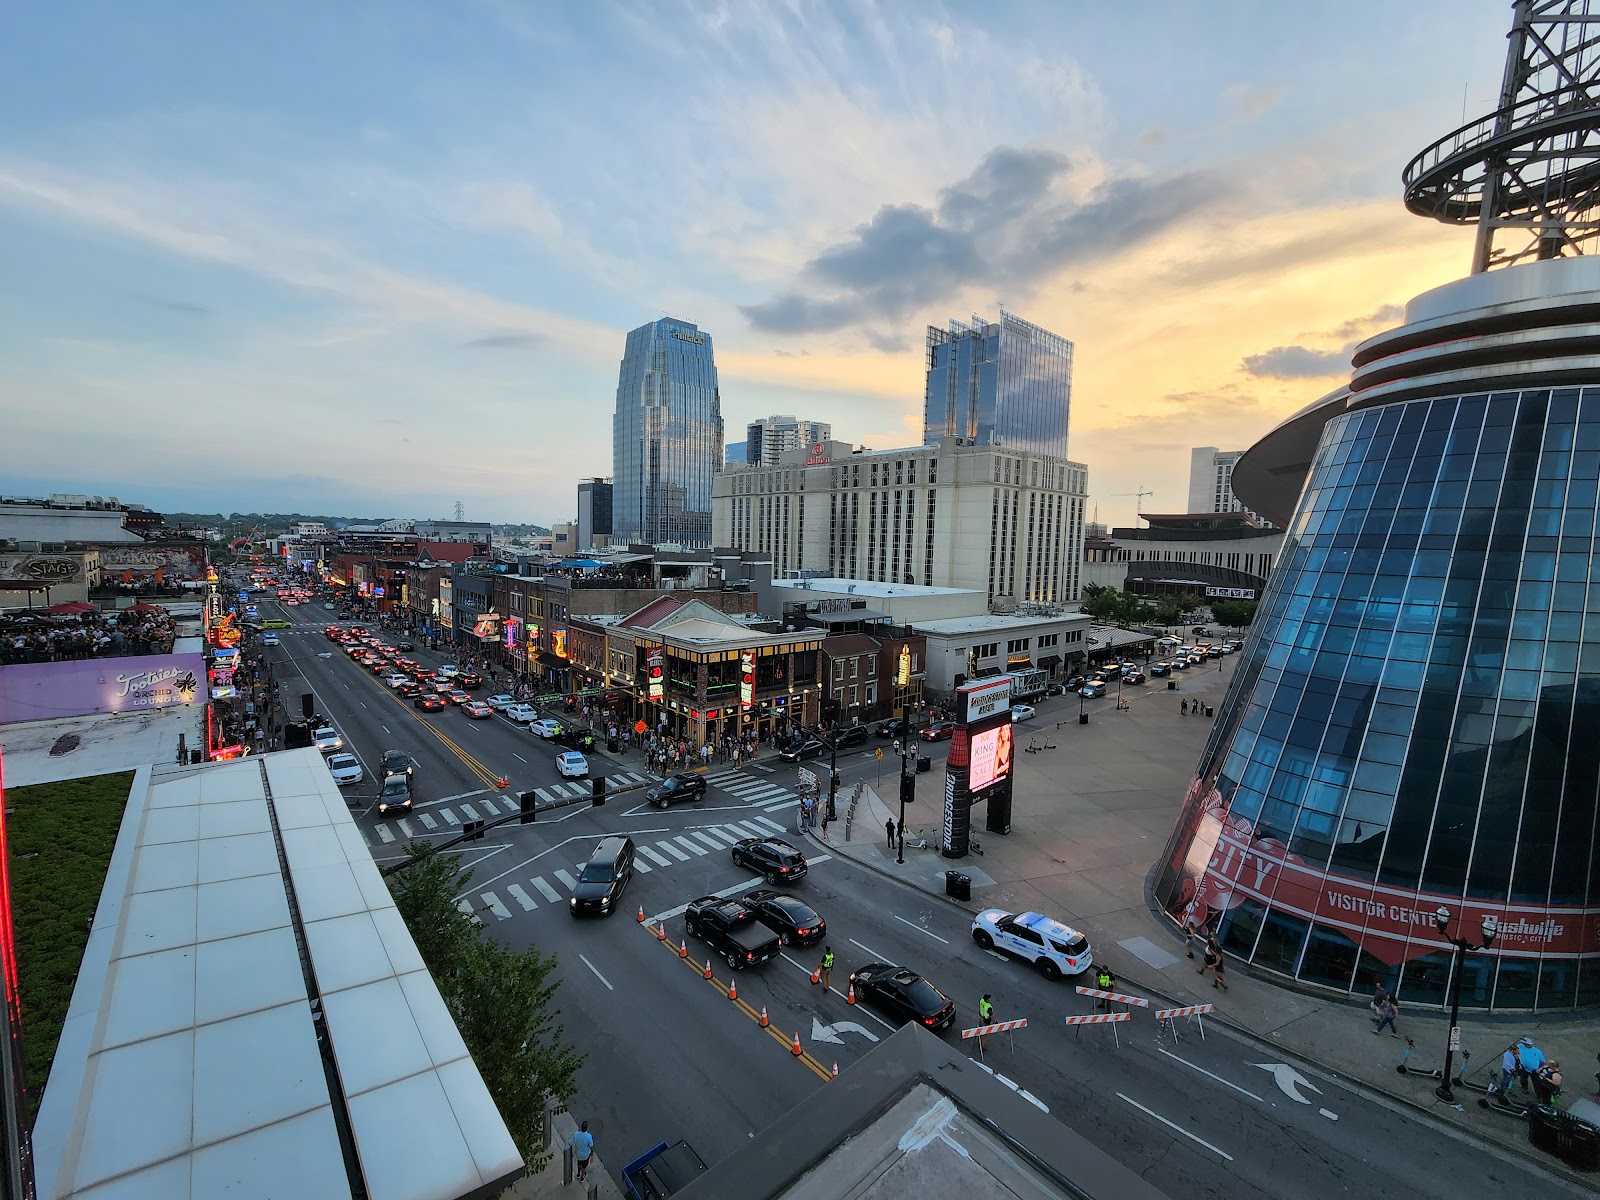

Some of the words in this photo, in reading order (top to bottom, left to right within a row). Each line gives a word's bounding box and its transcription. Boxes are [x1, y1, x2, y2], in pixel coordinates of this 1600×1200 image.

[29, 561, 77, 576] STAGE
[116, 667, 184, 697] Tootsies
[133, 688, 173, 698] ORCHID
[133, 696, 181, 706] LOUNGE
[970, 690, 1009, 707] BRIDGESTONE
[974, 742, 994, 758] KING
[974, 763, 993, 777] SALE
[943, 771, 956, 851] BRIDGESTONE
[1208, 839, 1275, 890] CITY
[1327, 890, 1387, 919] VISITOR
[1388, 905, 1438, 928] CENTE
[1496, 933, 1522, 942] MUSIC
[1529, 935, 1547, 943] CITY
